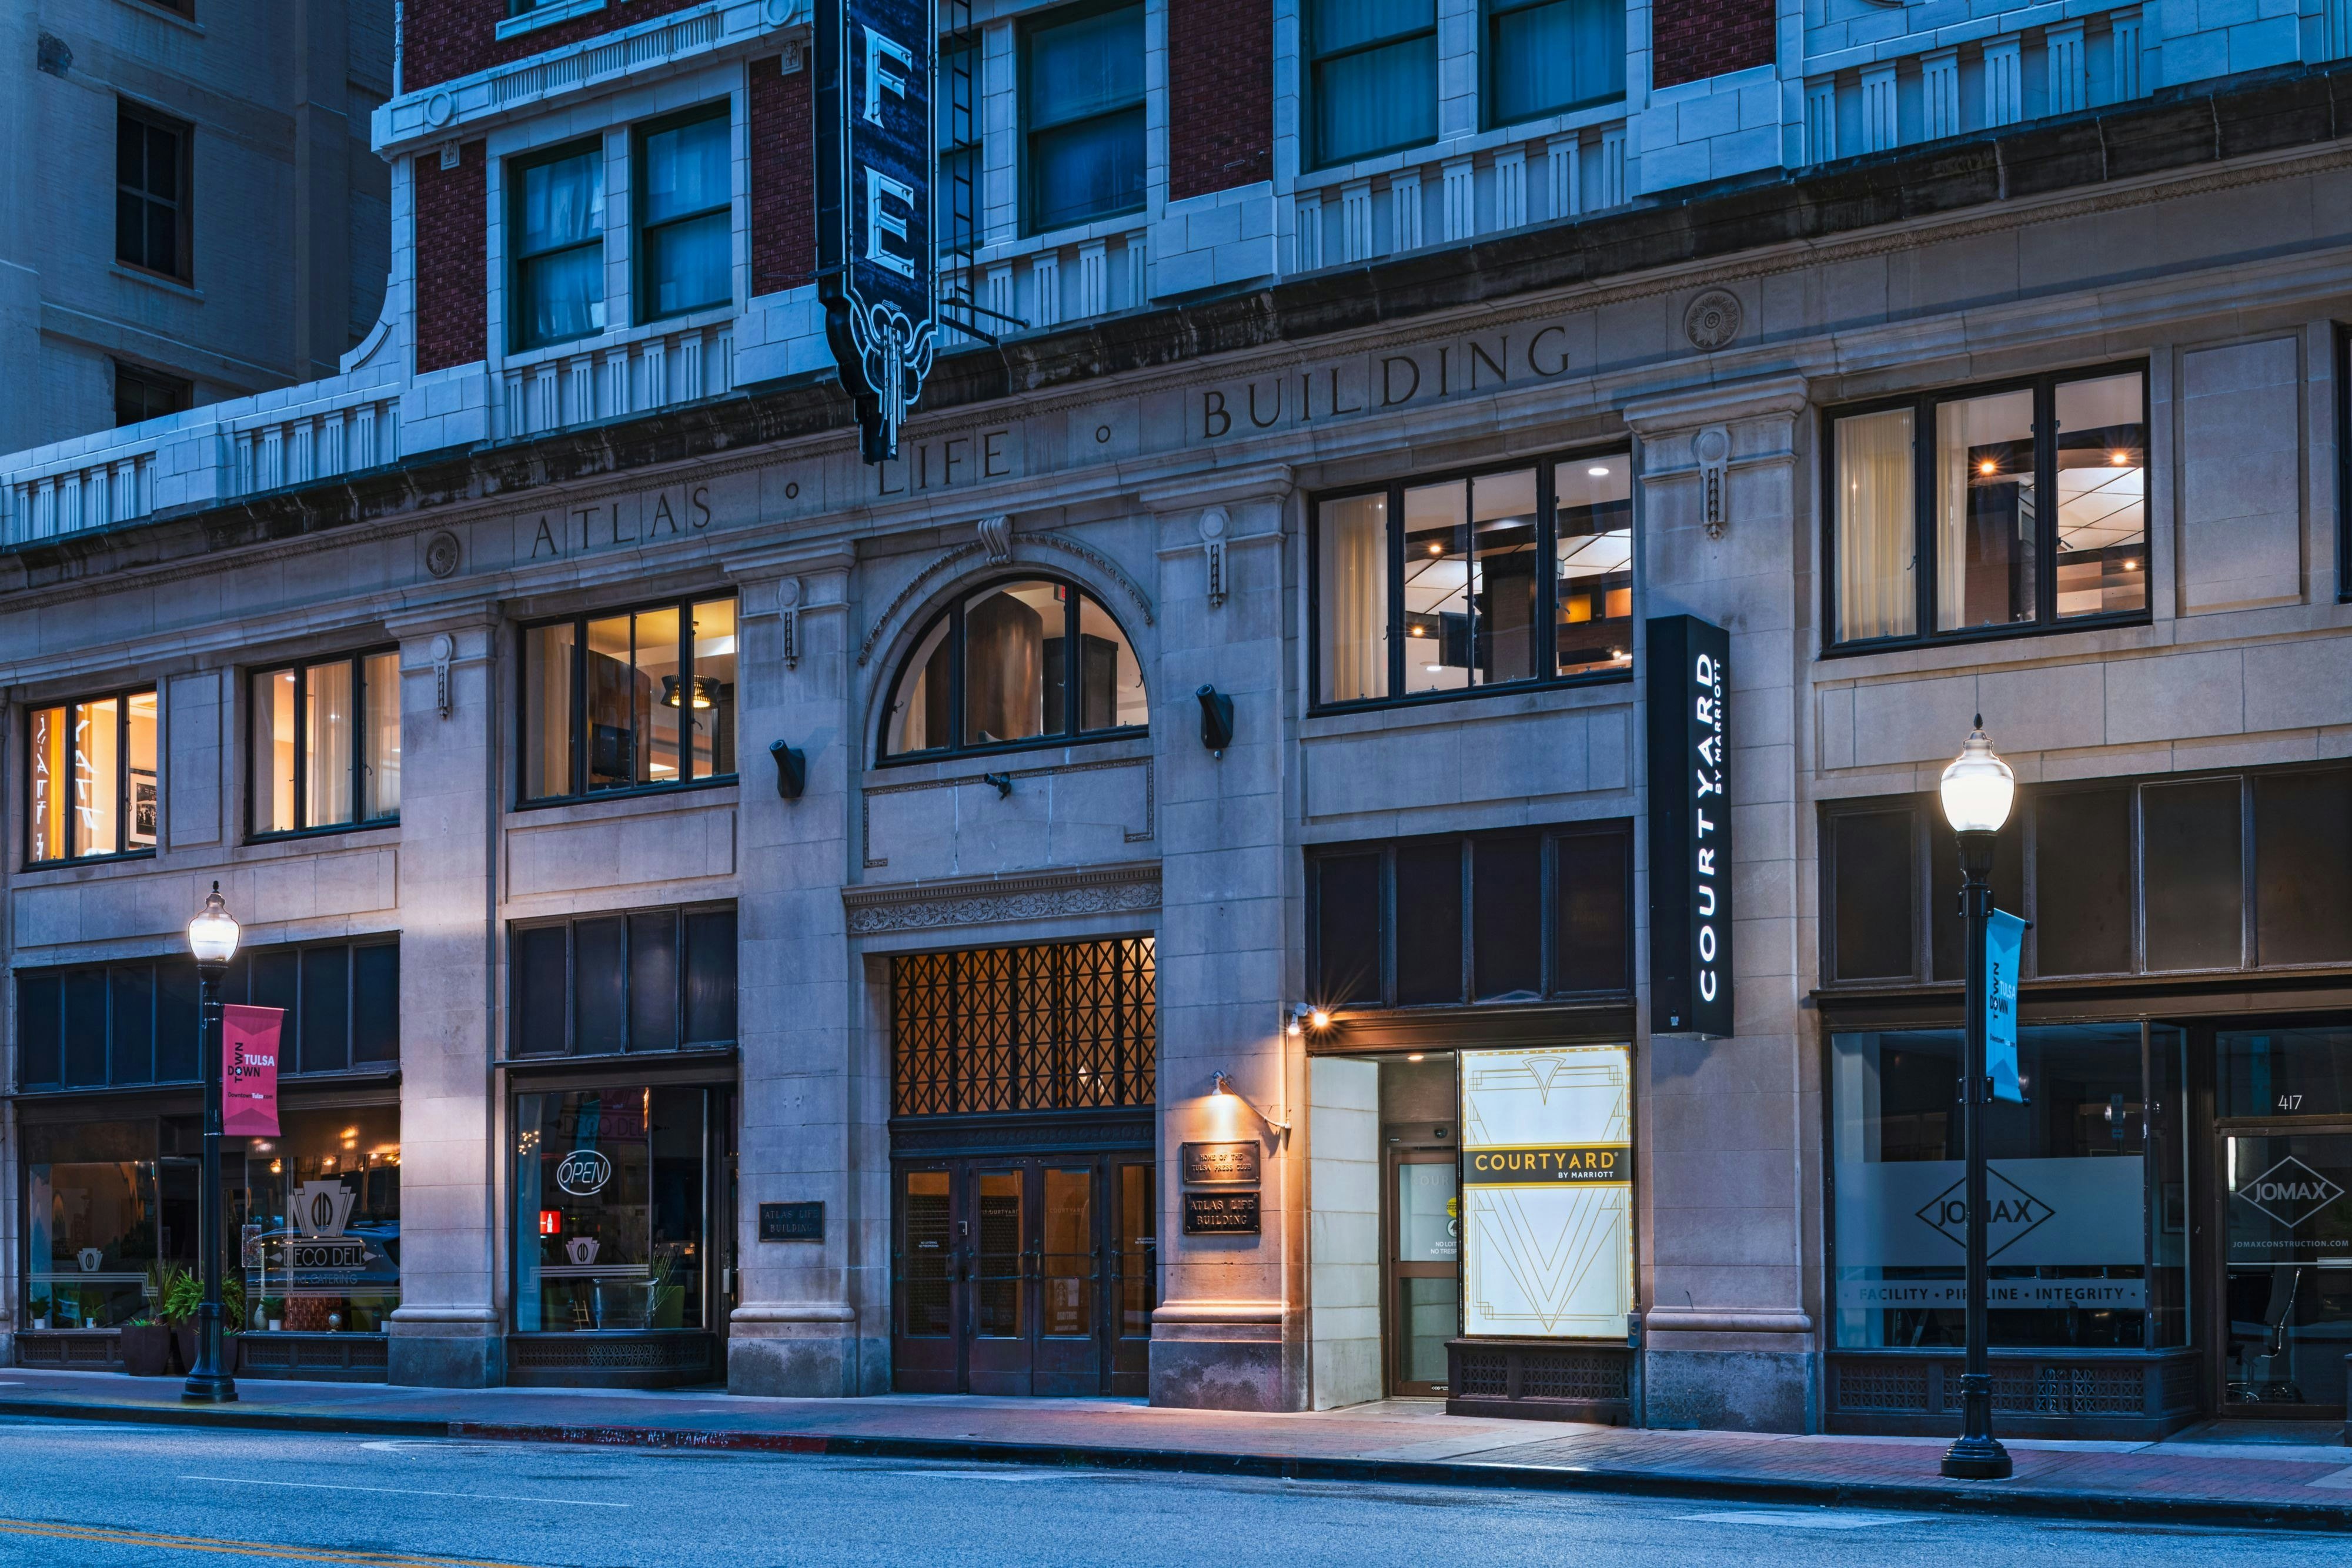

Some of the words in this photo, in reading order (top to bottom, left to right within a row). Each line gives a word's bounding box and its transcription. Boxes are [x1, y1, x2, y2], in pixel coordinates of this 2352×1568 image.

[530, 487, 711, 559] ATLAS
[878, 429, 1011, 496] LIFE
[1203, 326, 1571, 439] BUILDING
[1713, 661, 1722, 763] MARRIOTT
[1714, 770, 1722, 794] BY
[1696, 653, 1716, 1002] COURTYARD
[1999, 981, 2016, 1001] TULSA
[1990, 994, 2008, 1015] DOWN
[244, 1054, 275, 1066] TULSA
[228, 1065, 260, 1078] DOWN
[2278, 1095, 2303, 1110] 417
[1200, 1154, 1216, 1162] HOME
[1219, 1153, 1227, 1161] OF
[1231, 1152, 1243, 1161] THE
[1475, 1152, 1614, 1171] COURTYARD
[560, 1161, 606, 1184] OPEN
[1191, 1164, 1211, 1173] TULSA
[1214, 1164, 1233, 1173] PRESS
[1237, 1163, 1252, 1172] CLUB
[2254, 1182, 2327, 1203] JOMAX
[1190, 1200, 1224, 1211] ATLAS
[1231, 1200, 1254, 1210] LIFE
[764, 1210, 793, 1219] ATLAS
[799, 1209, 818, 1219] LIFE
[1197, 1215, 1248, 1225] BUILDING
[770, 1223, 813, 1233] BUILDING
[2233, 1240, 2349, 1248] JOMAXCONSTRUCTION.COM
[333, 1248, 362, 1266] DELI
[310, 1273, 358, 1285] CATERING
[1859, 1288, 1928, 1300] FACILITY
[1946, 1288, 2018, 1300] PIPINE
[2036, 1288, 2124, 1300] INTEGRITY
